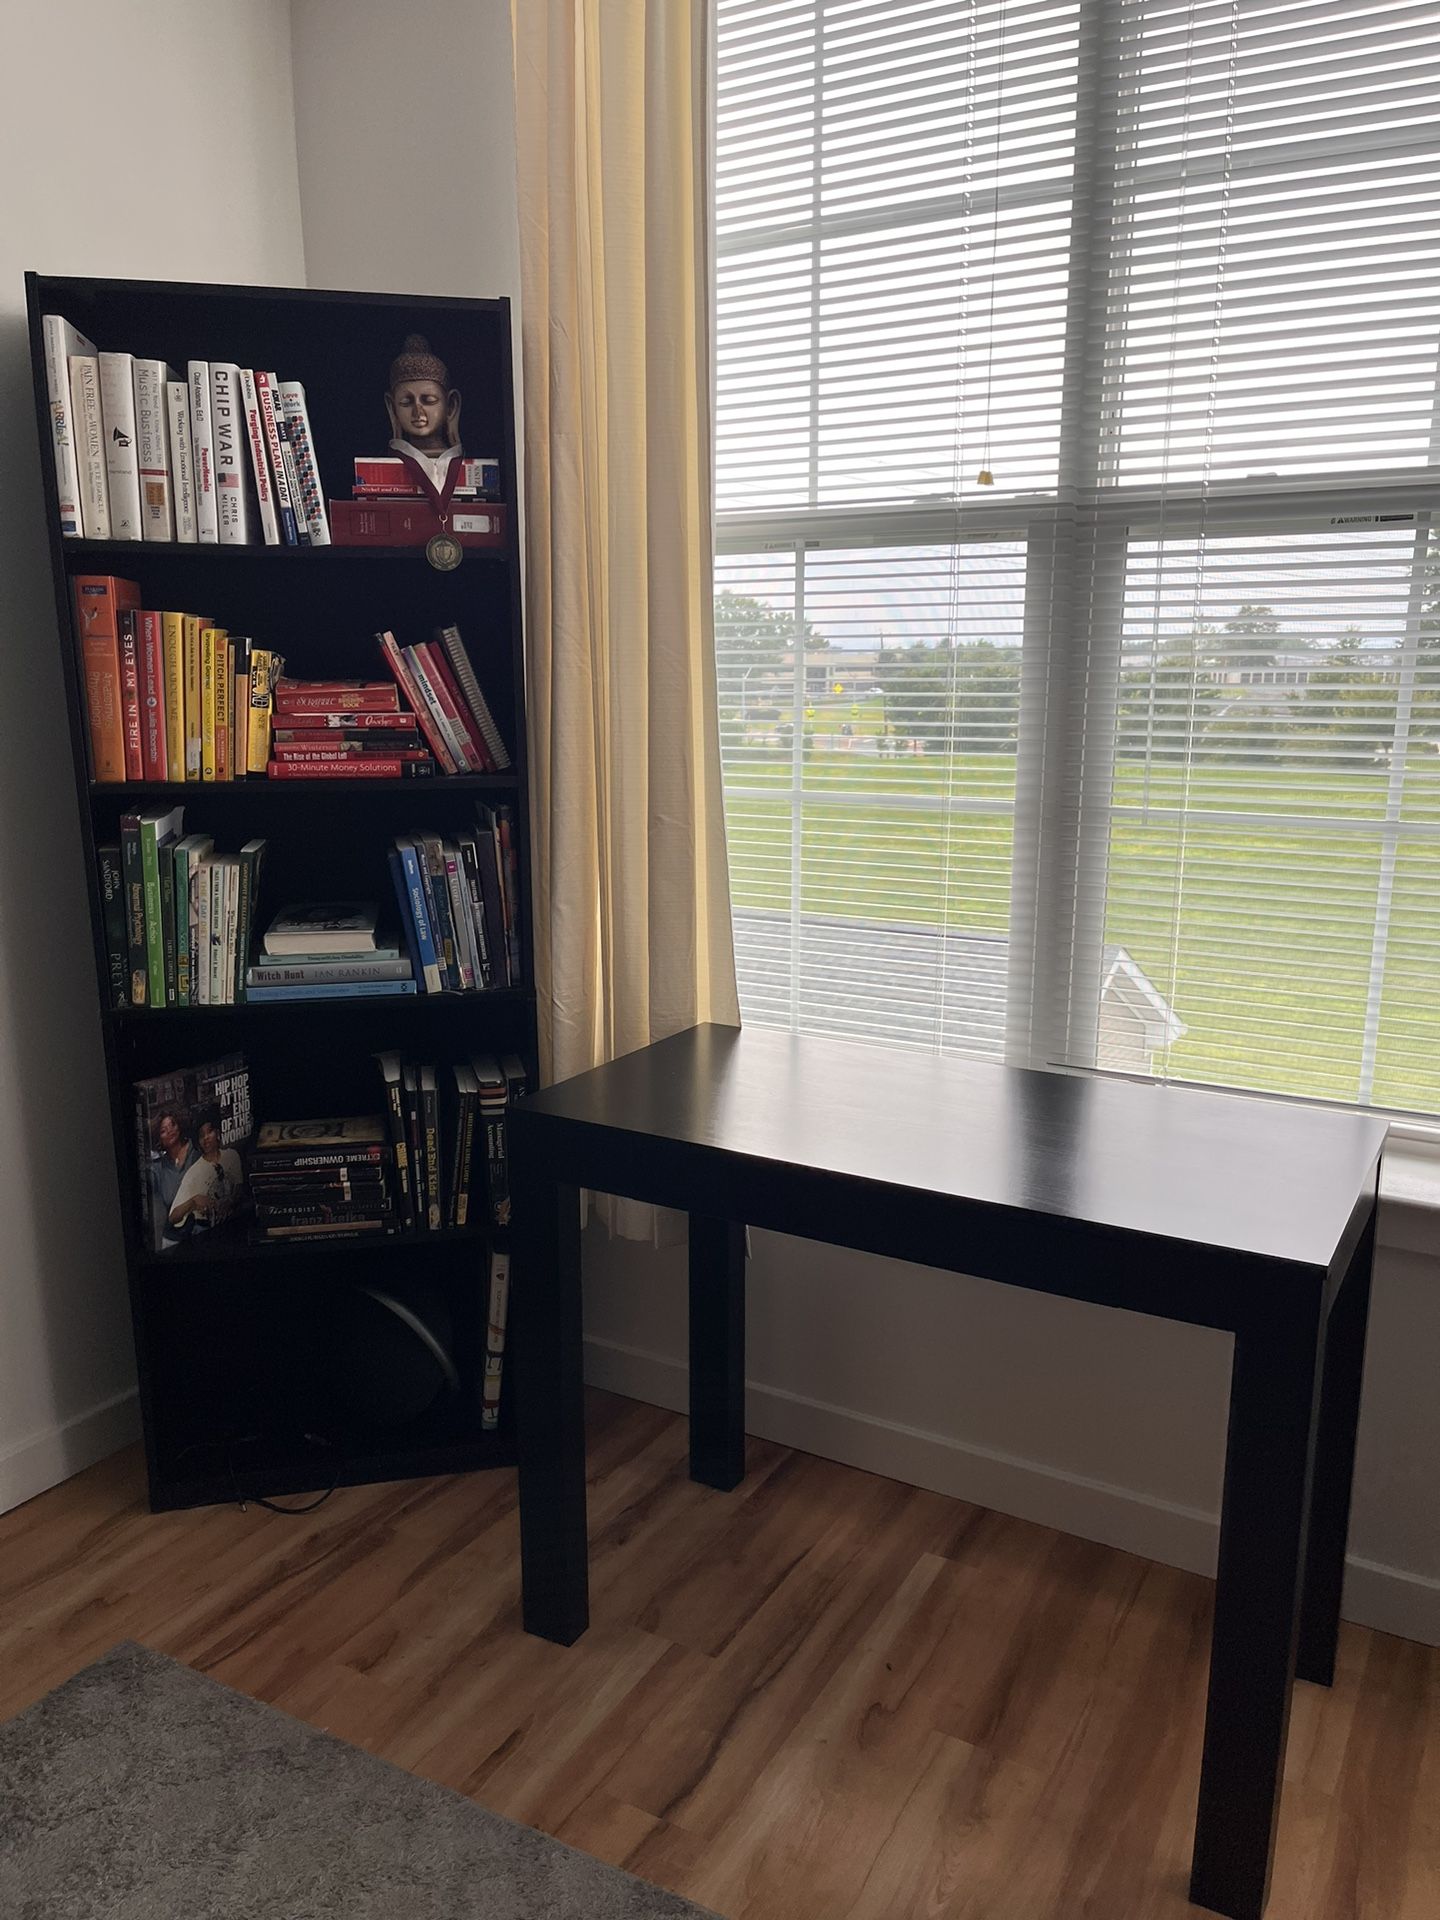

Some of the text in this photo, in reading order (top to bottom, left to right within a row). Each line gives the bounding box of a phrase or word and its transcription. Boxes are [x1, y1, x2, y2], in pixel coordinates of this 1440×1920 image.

[83, 364, 92, 385] PAIN
[85, 387, 95, 411] FREE
[138, 369, 152, 463] Music Business
[176, 411, 185, 435] Working
[215, 371, 233, 465] CHIP WAR
[262, 391, 277, 441] BUSINESS
[271, 442, 283, 469] PLAN
[88, 421, 99, 456] WOMEN
[180, 452, 188, 481] Emotional
[201, 448, 211, 492] PowerNomics
[249, 410, 269, 502] Forging Industrial Policy
[221, 494, 230, 526] MILLER
[230, 496, 238, 523] CHRIS
[144, 616, 156, 694] When Women Lead
[168, 624, 177, 669] ENOUGH
[88, 671, 103, 728] Physiology
[102, 671, 115, 719] Anatomy
[123, 634, 137, 748] FIRE IN MY EYES
[169, 670, 177, 704] ABOUT
[216, 653, 225, 722] PITCH PERFECT
[418, 674, 436, 705] mindset
[170, 708, 178, 721] ME
[287, 763, 328, 771] 30-Minute
[331, 763, 358, 772] Money
[360, 763, 397, 771] Solutions
[305, 752, 311, 760] of
[312, 752, 320, 760] the
[321, 752, 337, 760] Global
[338, 751, 347, 759] Left
[102, 859, 113, 900] SANDFORD
[111, 870, 120, 889] JOHN
[132, 883, 145, 945] Abnormal Psychology
[146, 882, 157, 944] Business Action
[412, 888, 424, 918] Sociology
[111, 953, 123, 988] PREY
[257, 970, 304, 981] Witch Hunt
[314, 968, 381, 978] IAN RANKIN
[215, 1073, 249, 1096] HIP HOP
[221, 1086, 249, 1108] AT THE
[221, 1112, 251, 1132] OF THE
[233, 1099, 250, 1115] END
[221, 1124, 251, 1146] WORLD
[487, 1123, 495, 1159] Accounting
[496, 1123, 505, 1159] Managerial
[294, 1153, 380, 1166] EXTREME OWNERSHIP
[427, 1128, 437, 1196] Dead End Kids
[283, 1206, 316, 1214] SOLOIST
